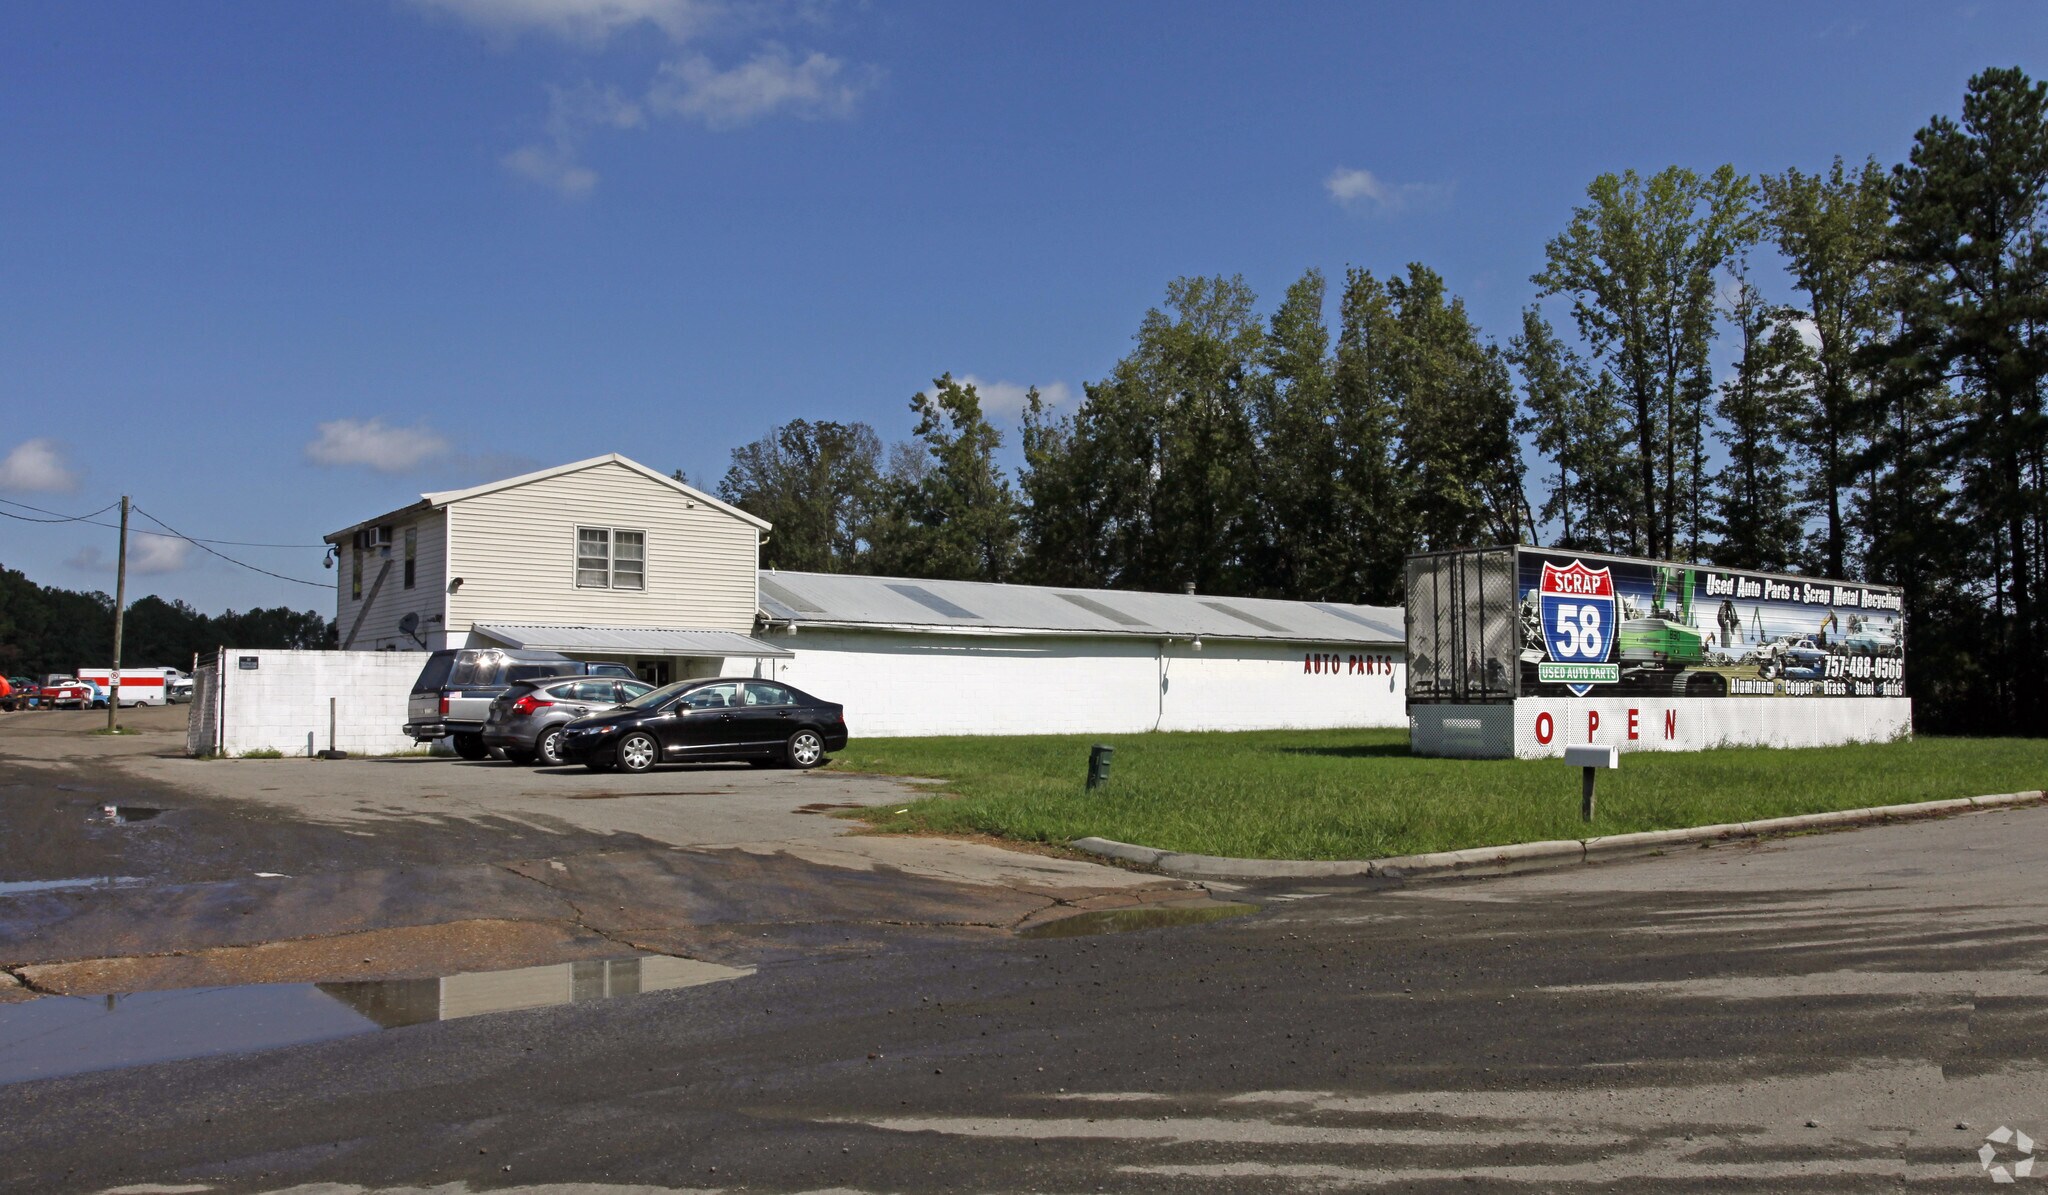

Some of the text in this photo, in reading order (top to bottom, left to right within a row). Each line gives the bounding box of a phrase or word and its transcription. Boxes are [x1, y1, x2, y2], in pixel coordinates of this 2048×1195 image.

[1555, 572, 1601, 594] SCRAP
[1706, 574, 1901, 611] Used Auto Parts & Scrap Metal Recycling
[1556, 604, 1602, 658] 58
[1304, 653, 1392, 676] AUTO PARTS
[1542, 666, 1616, 680] USED AUTO PARTS
[1824, 655, 1903, 679] 757-488-0566
[1731, 679, 1903, 696] Aluminum Copper Brass Steel Autos
[1535, 709, 1677, 745] OPEN
